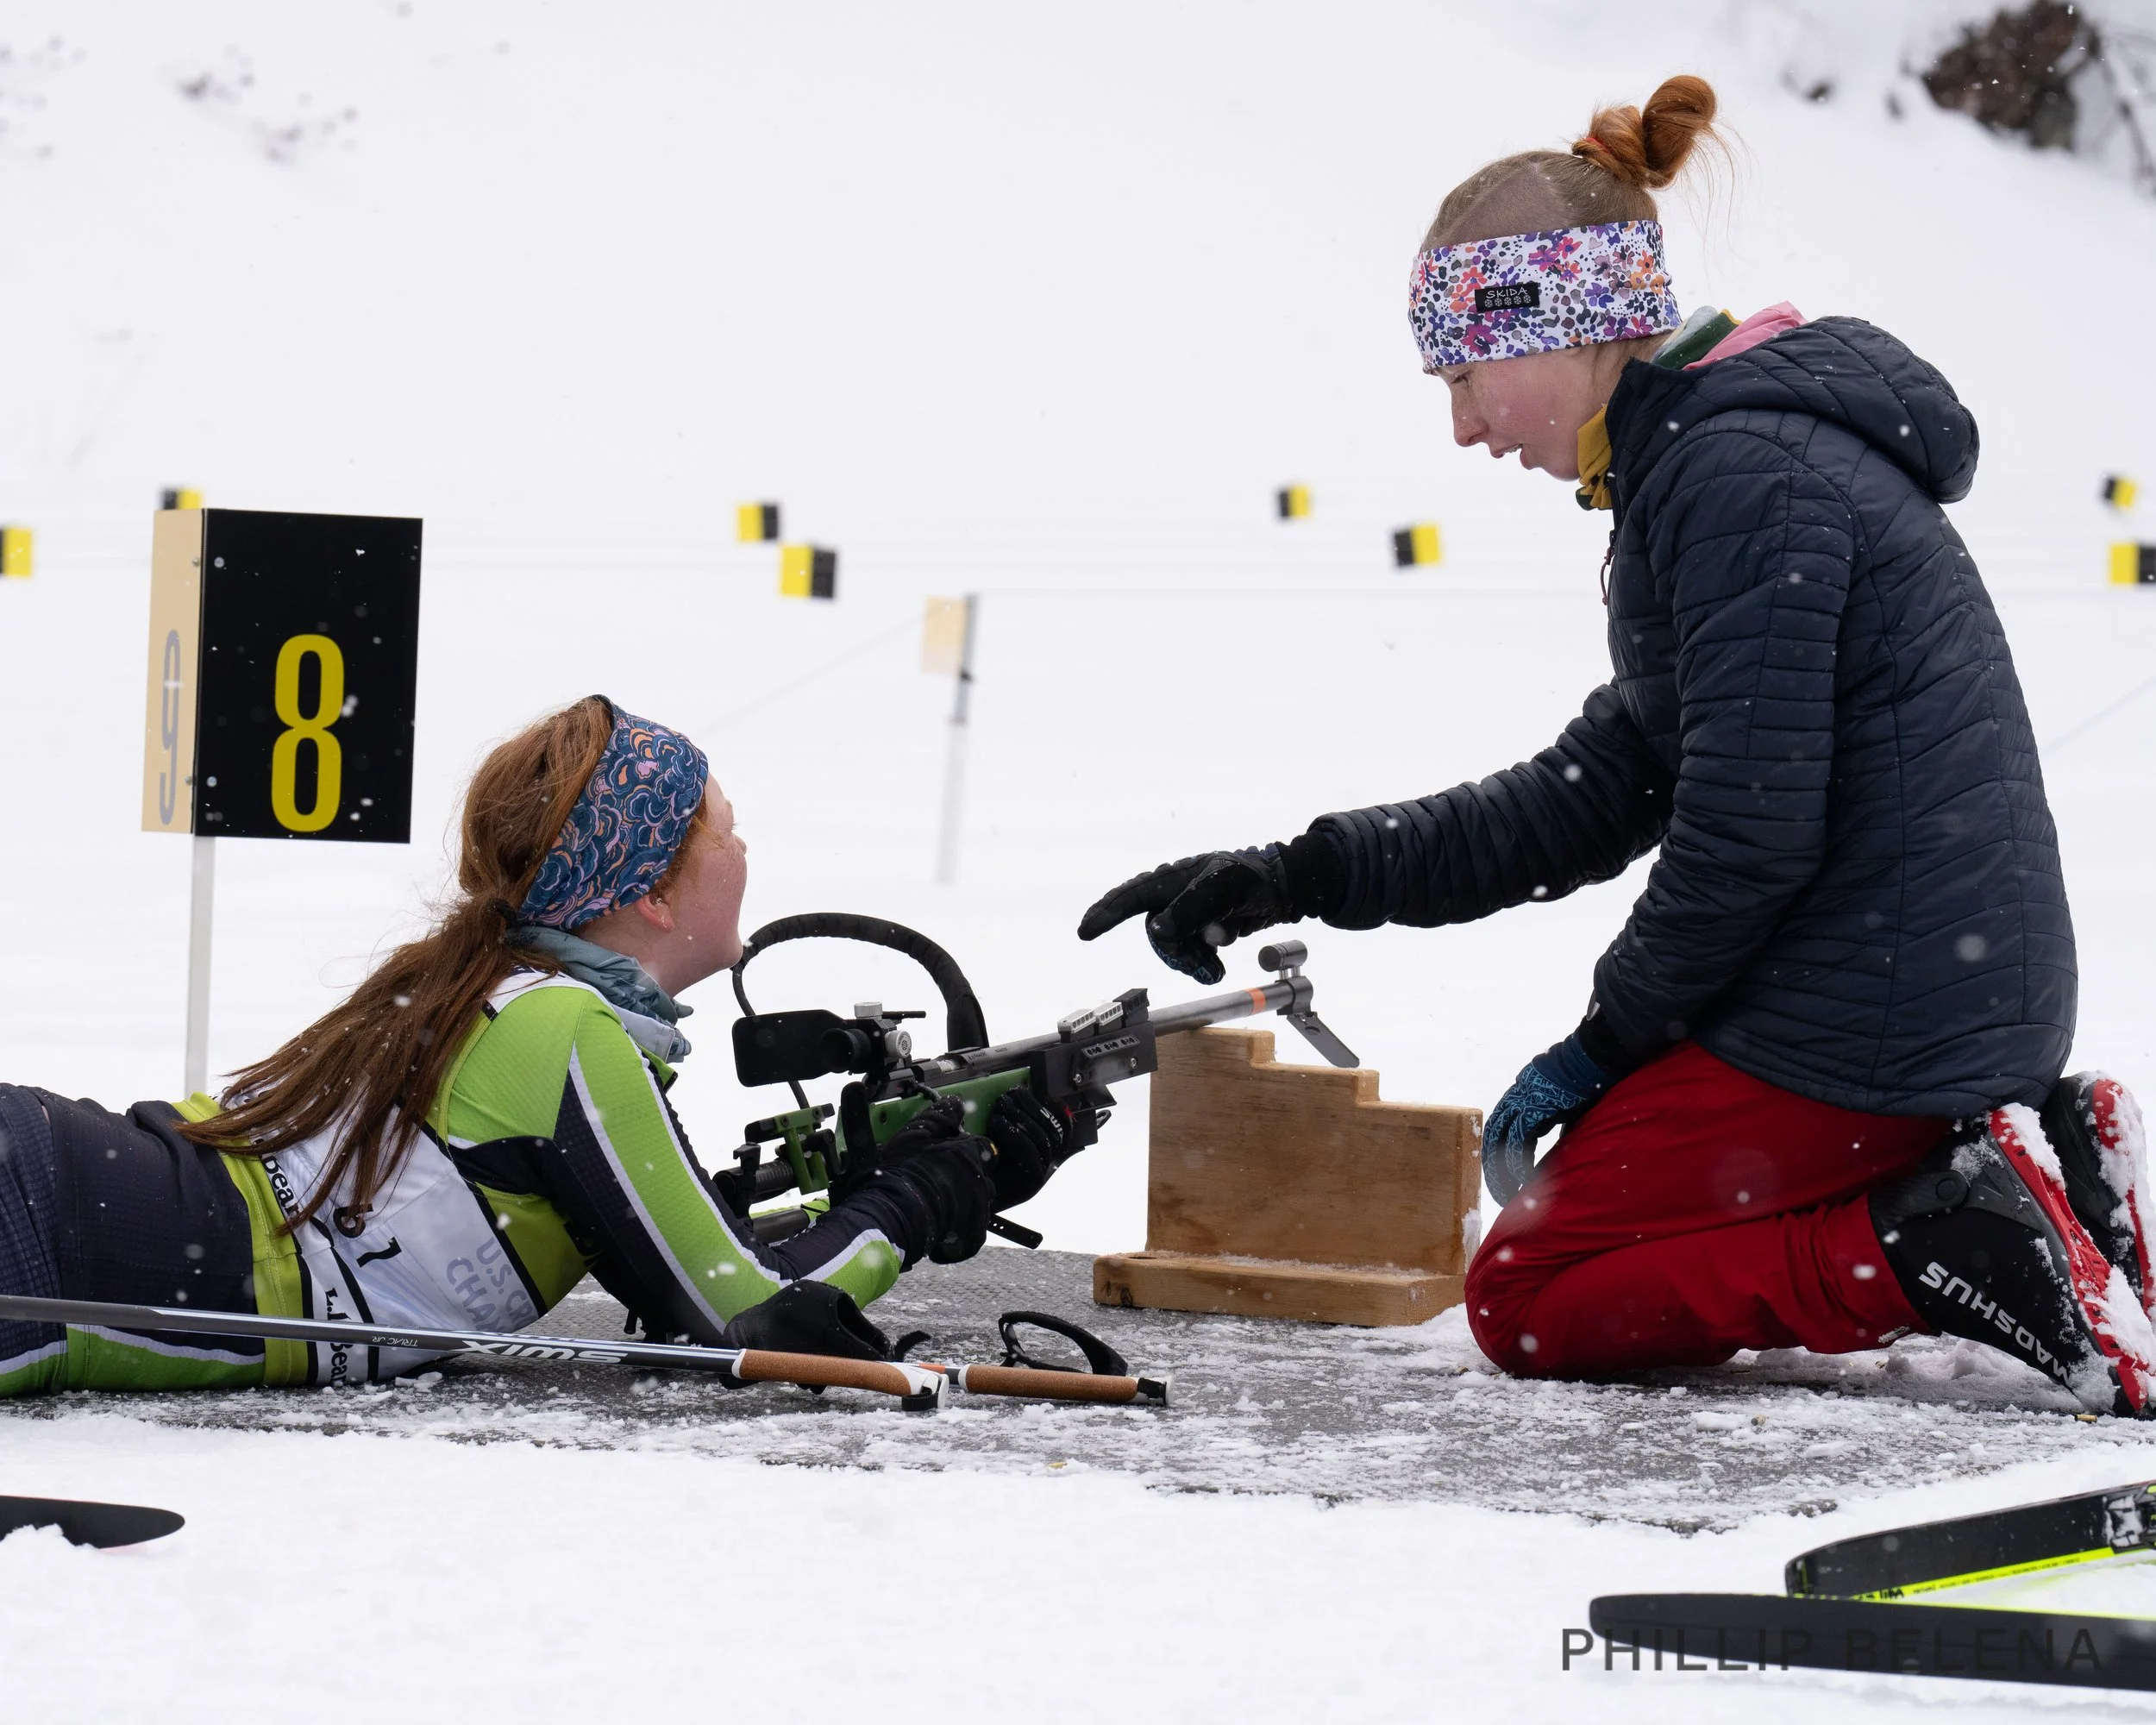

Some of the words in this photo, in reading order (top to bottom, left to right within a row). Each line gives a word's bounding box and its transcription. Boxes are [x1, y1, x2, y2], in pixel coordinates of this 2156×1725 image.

[1486, 286, 1528, 299] SKIDA
[159, 629, 181, 825] 9
[271, 633, 346, 833] 8
[476, 1236, 512, 1295] U.S.
[387, 1337, 419, 1347] TRIAC
[1918, 1261, 2071, 1387] MADSHUS
